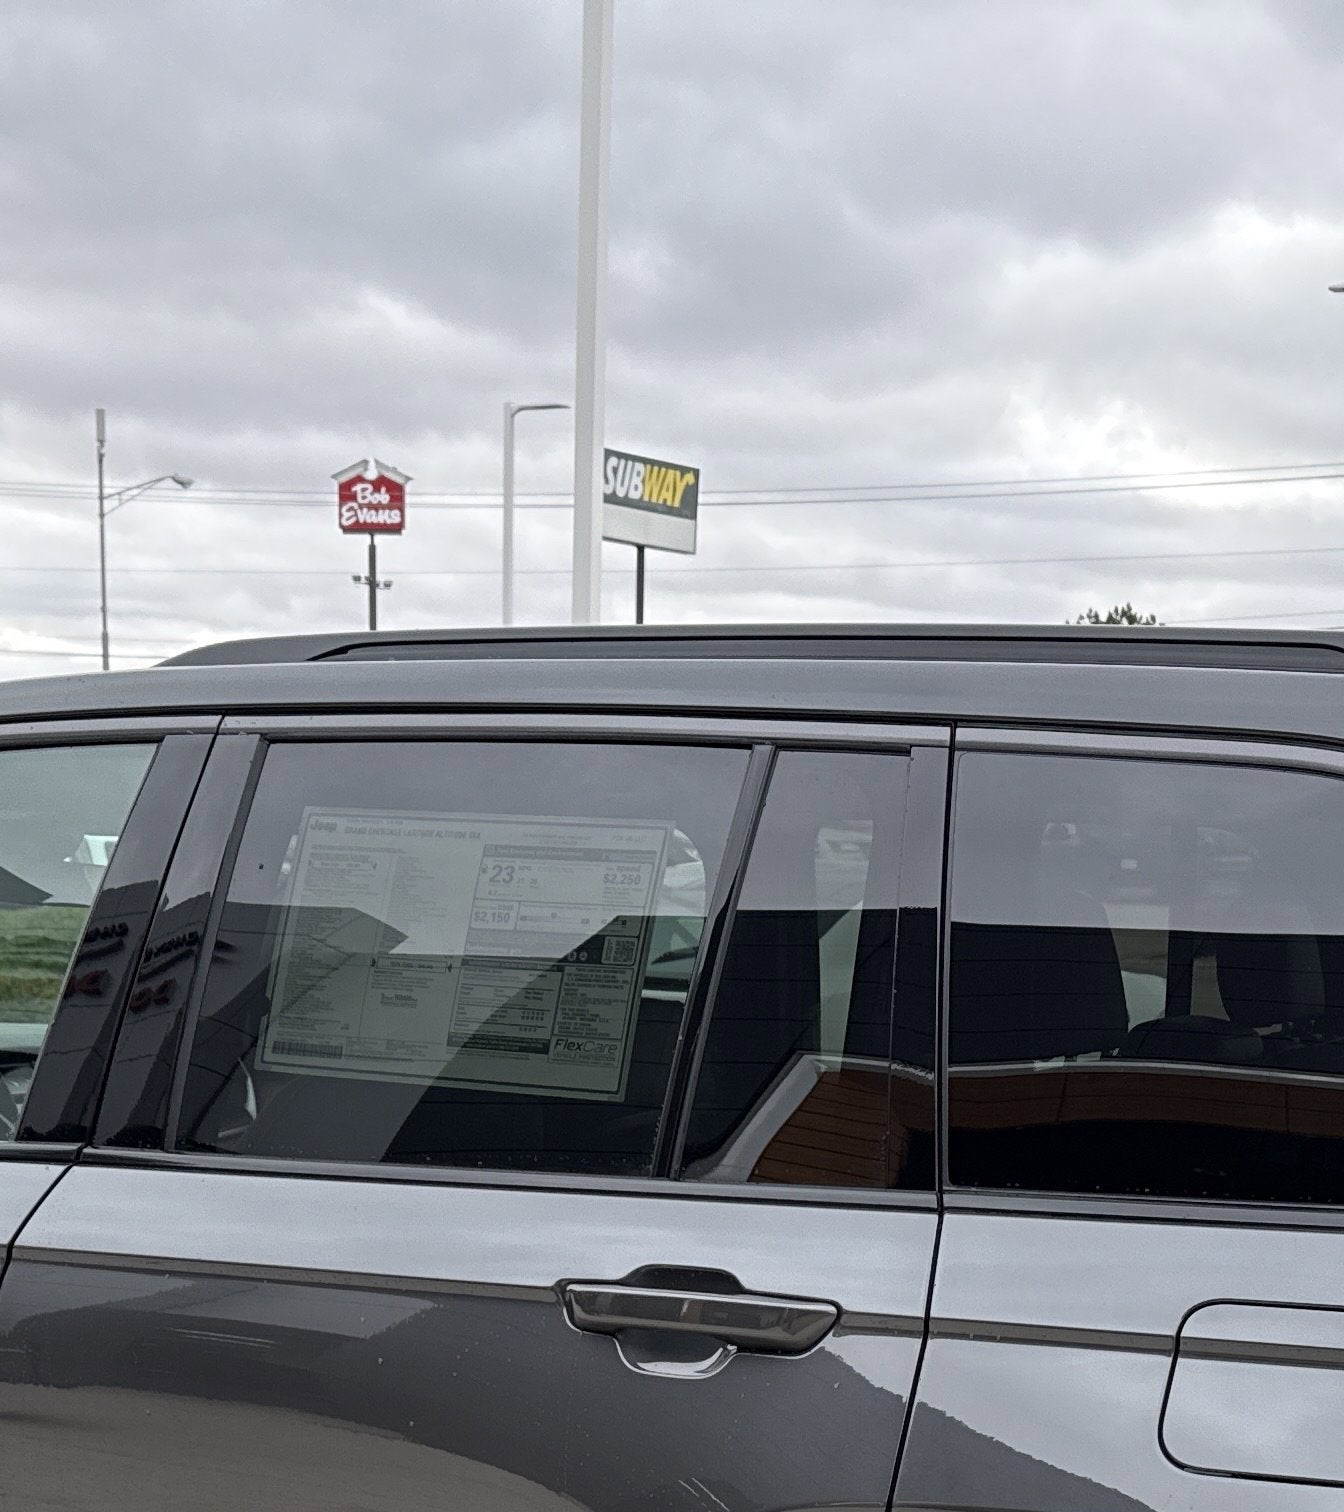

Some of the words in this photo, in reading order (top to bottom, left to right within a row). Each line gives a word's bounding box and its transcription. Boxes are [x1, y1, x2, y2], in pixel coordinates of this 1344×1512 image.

[603, 456, 695, 508] SUBWAY
[351, 483, 390, 505] Bob
[340, 501, 401, 527] Evans
[488, 865, 516, 885] 23
[602, 873, 642, 886] $2,250
[472, 911, 511, 925] $2,150
[553, 1037, 619, 1055] FlexCare
